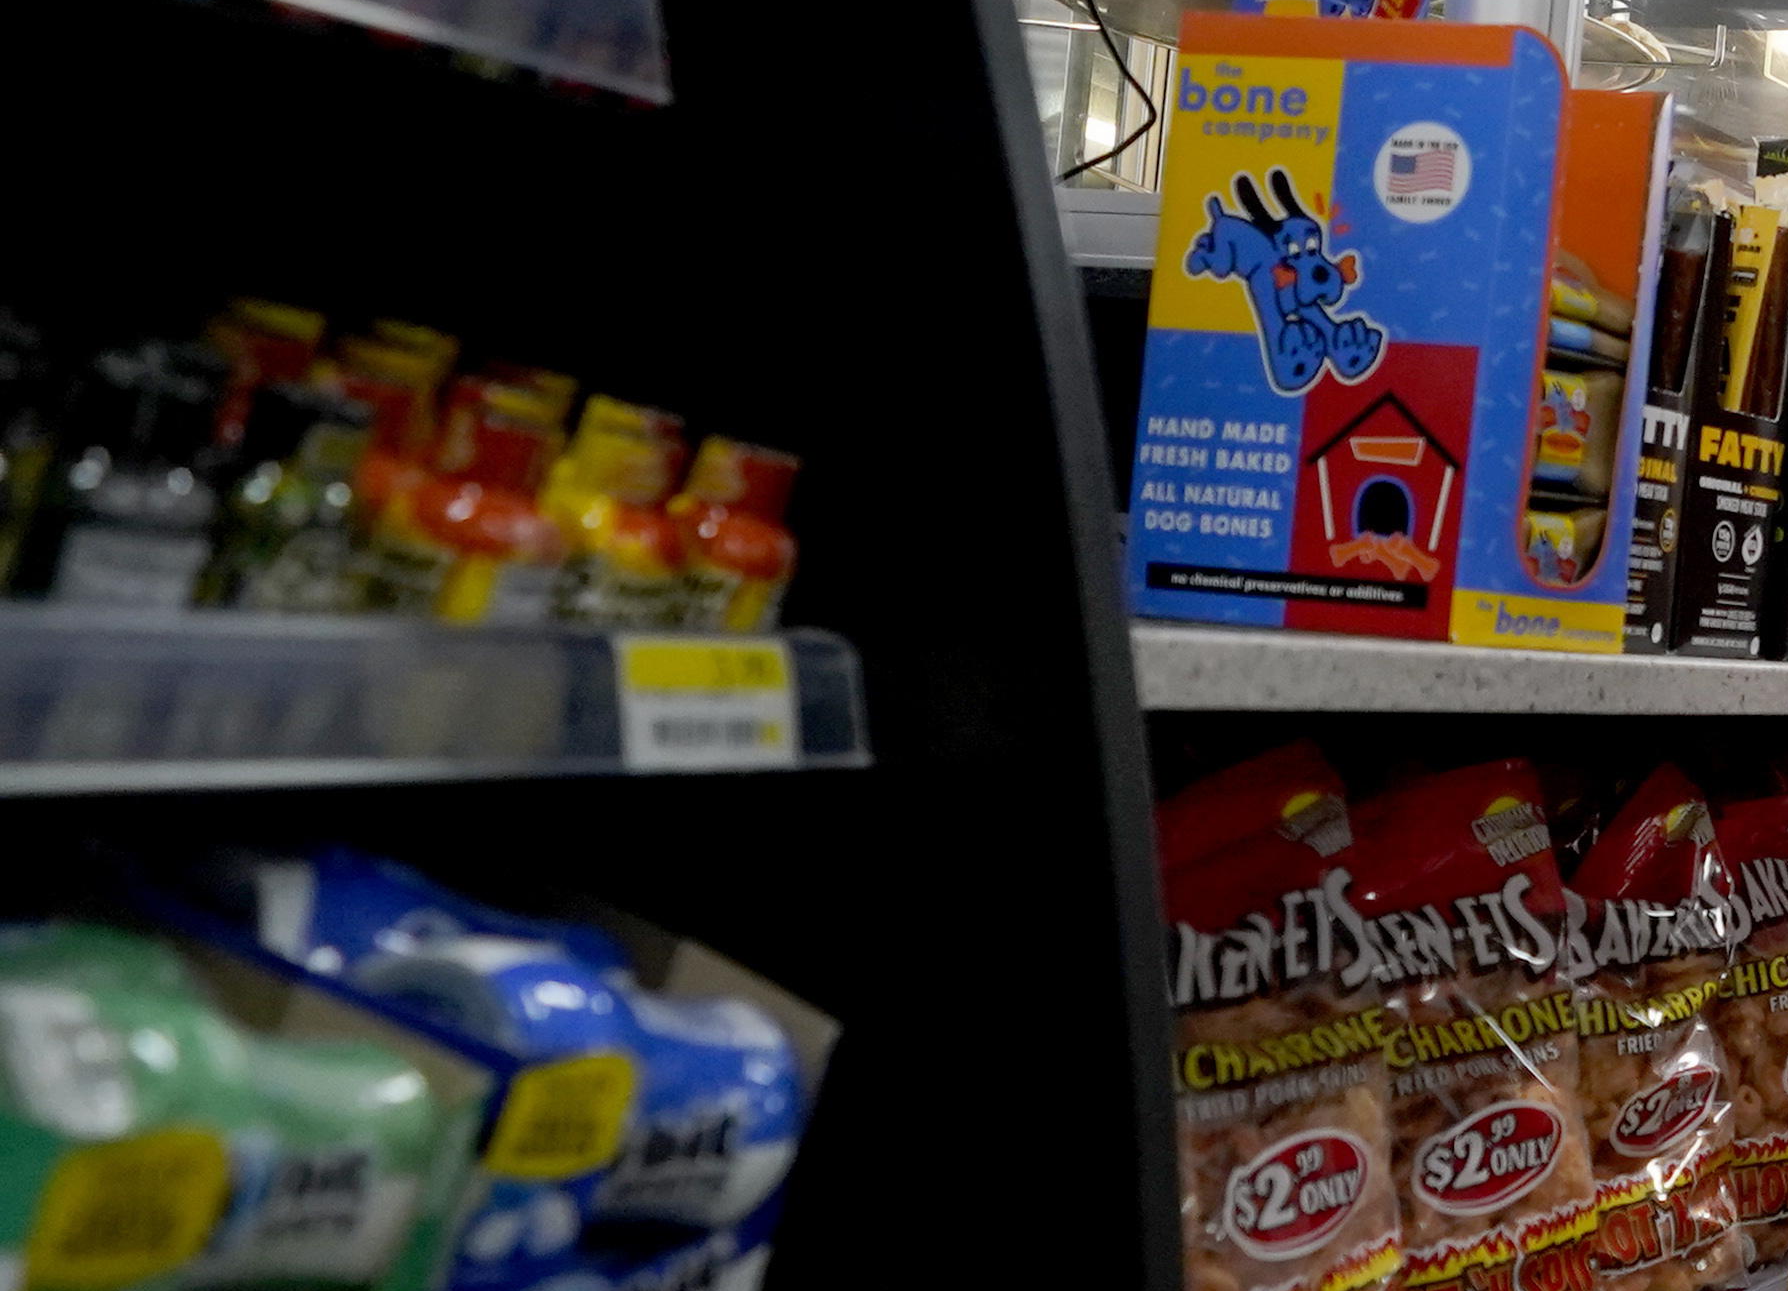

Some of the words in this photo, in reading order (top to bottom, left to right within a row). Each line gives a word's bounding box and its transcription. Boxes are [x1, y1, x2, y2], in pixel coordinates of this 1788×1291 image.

[1215, 63, 1244, 79] the
[1178, 67, 1308, 117] bone
[1202, 120, 1330, 146] company
[1147, 416, 1216, 440] HAND
[1221, 420, 1289, 445] MADE
[1139, 443, 1208, 468] FRESH
[1215, 448, 1292, 474] BAKED
[1699, 426, 1785, 476] FATTY
[1140, 481, 1176, 503] ALL
[1183, 484, 1282, 511] NATURAL
[1144, 510, 1193, 532] DOG
[1199, 514, 1273, 538] BONES
[1189, 572, 1243, 589] chemical
[1244, 577, 1326, 597] preservatives
[1345, 586, 1404, 602] additives
[1494, 602, 1561, 637] bone
[1491, 1136, 1554, 1175] ONLY
[1301, 1166, 1359, 1213] ONLY
